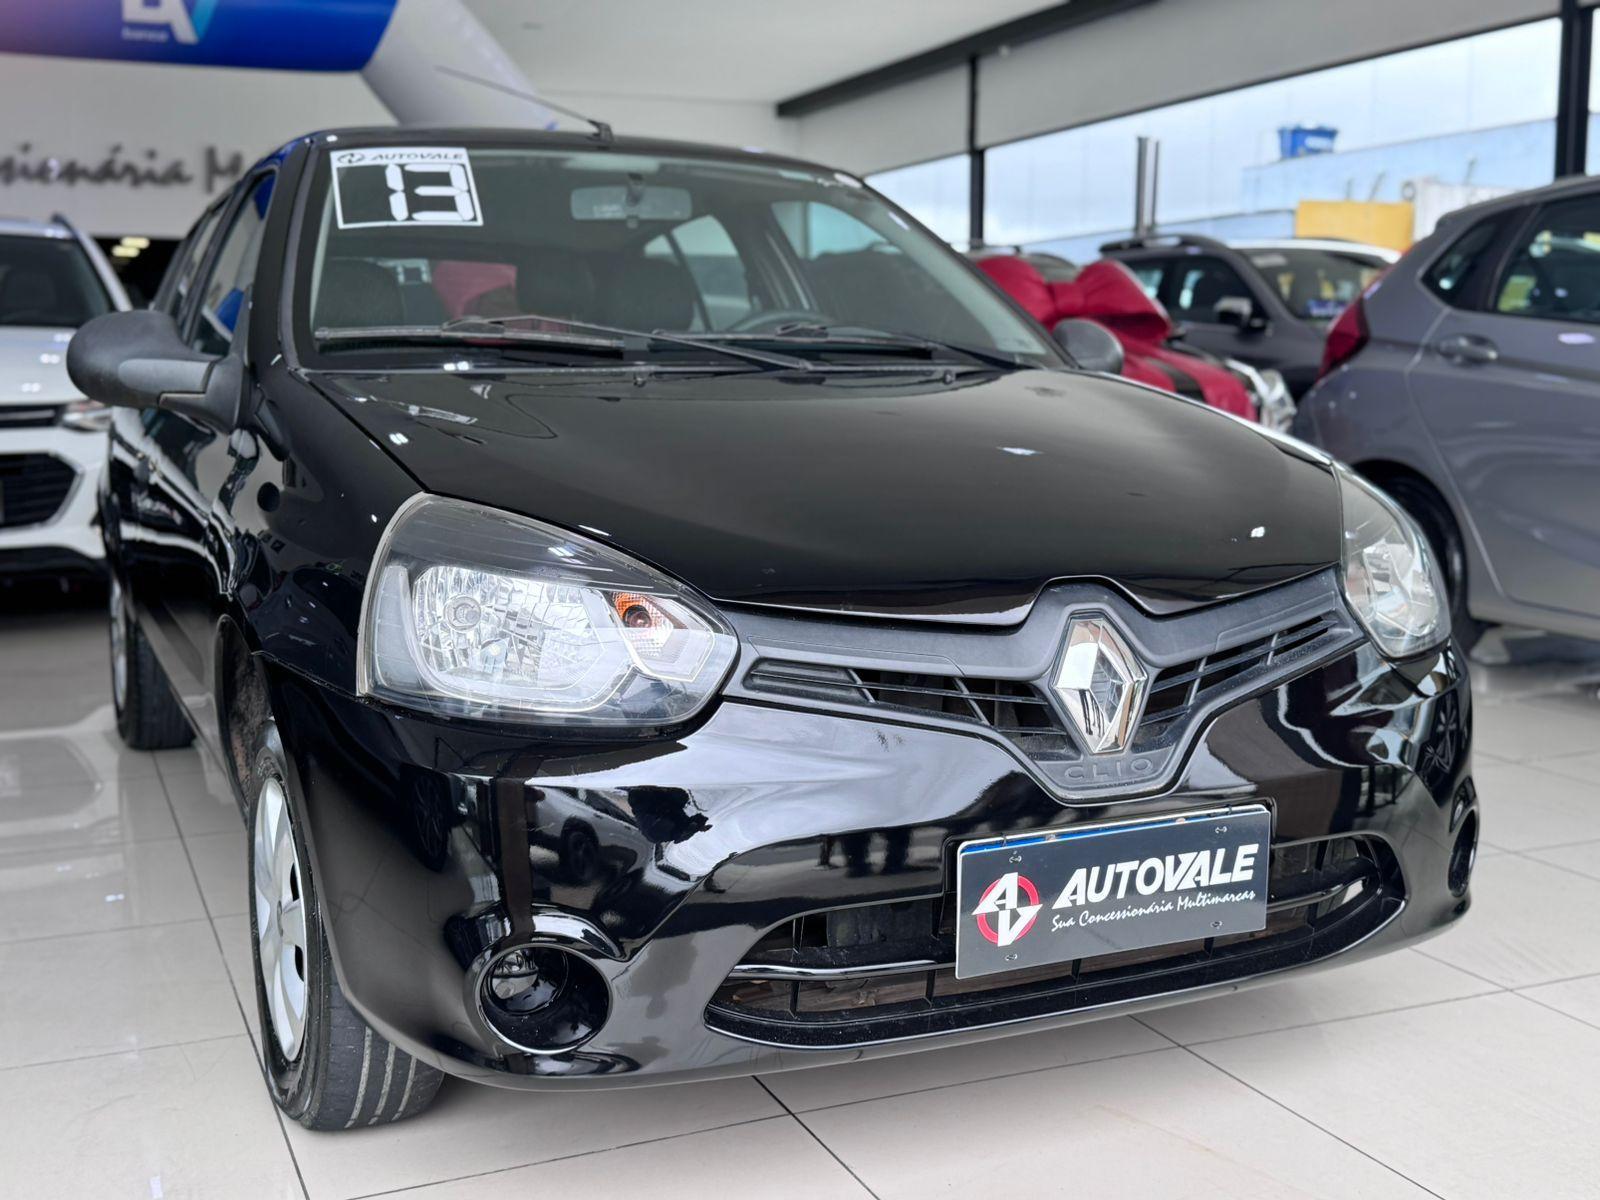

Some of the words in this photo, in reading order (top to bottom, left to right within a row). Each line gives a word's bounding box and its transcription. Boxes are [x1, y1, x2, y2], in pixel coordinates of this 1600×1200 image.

[371, 152, 464, 161] AUTOVALE
[385, 163, 475, 221] 13
[1064, 758, 1153, 779] CLIO
[1052, 844, 1259, 910] AUTOVALE
[1051, 914, 1076, 932] Sua
[1079, 901, 1173, 928] Concessionária
[1177, 889, 1256, 912] Multimarcas
